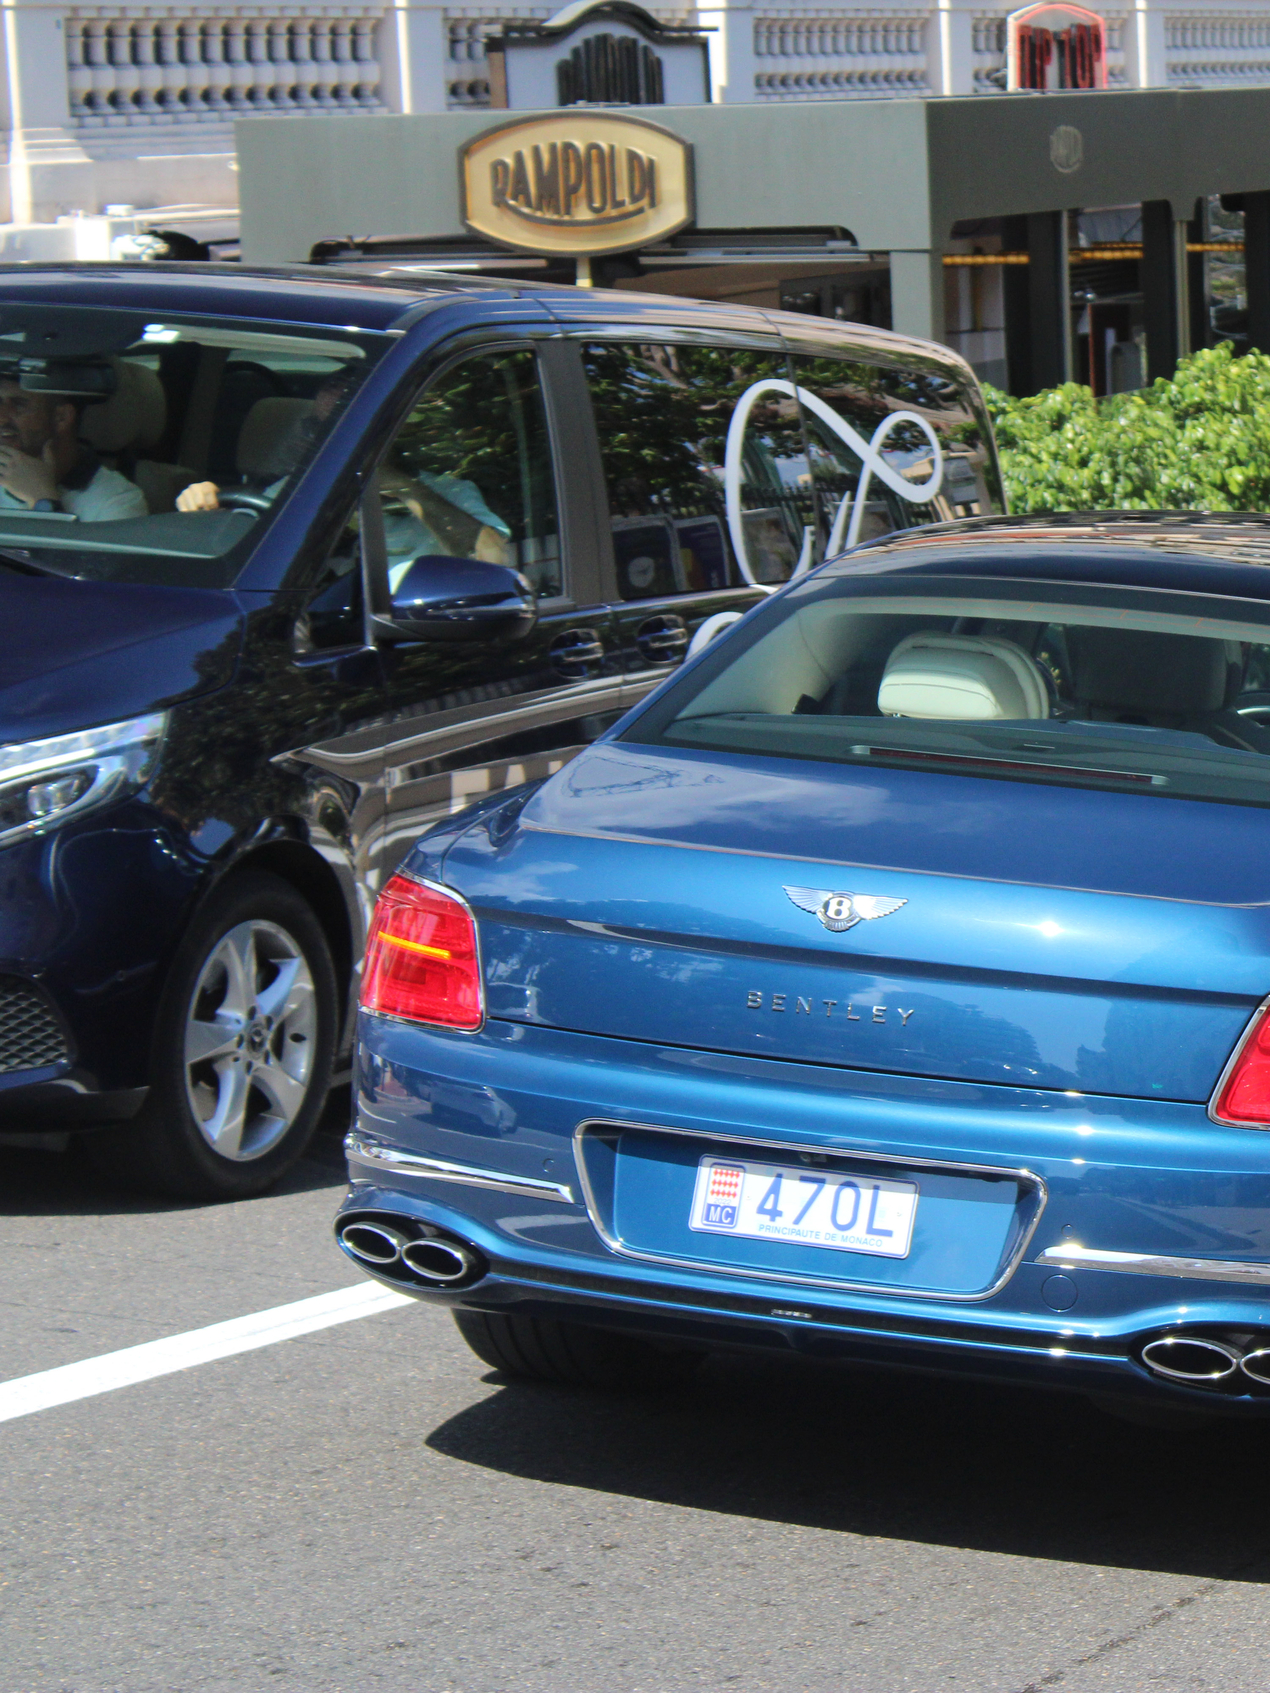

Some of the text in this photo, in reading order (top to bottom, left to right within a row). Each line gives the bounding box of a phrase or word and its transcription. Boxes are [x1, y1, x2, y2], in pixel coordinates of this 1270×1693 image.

[489, 140, 658, 227] RAMPOLDI
[747, 990, 914, 1026] BENTLEY
[709, 1205, 732, 1224] MC
[756, 1172, 894, 1239] 470L
[758, 1224, 884, 1248] PRINCIPAUTE DE MONACO
